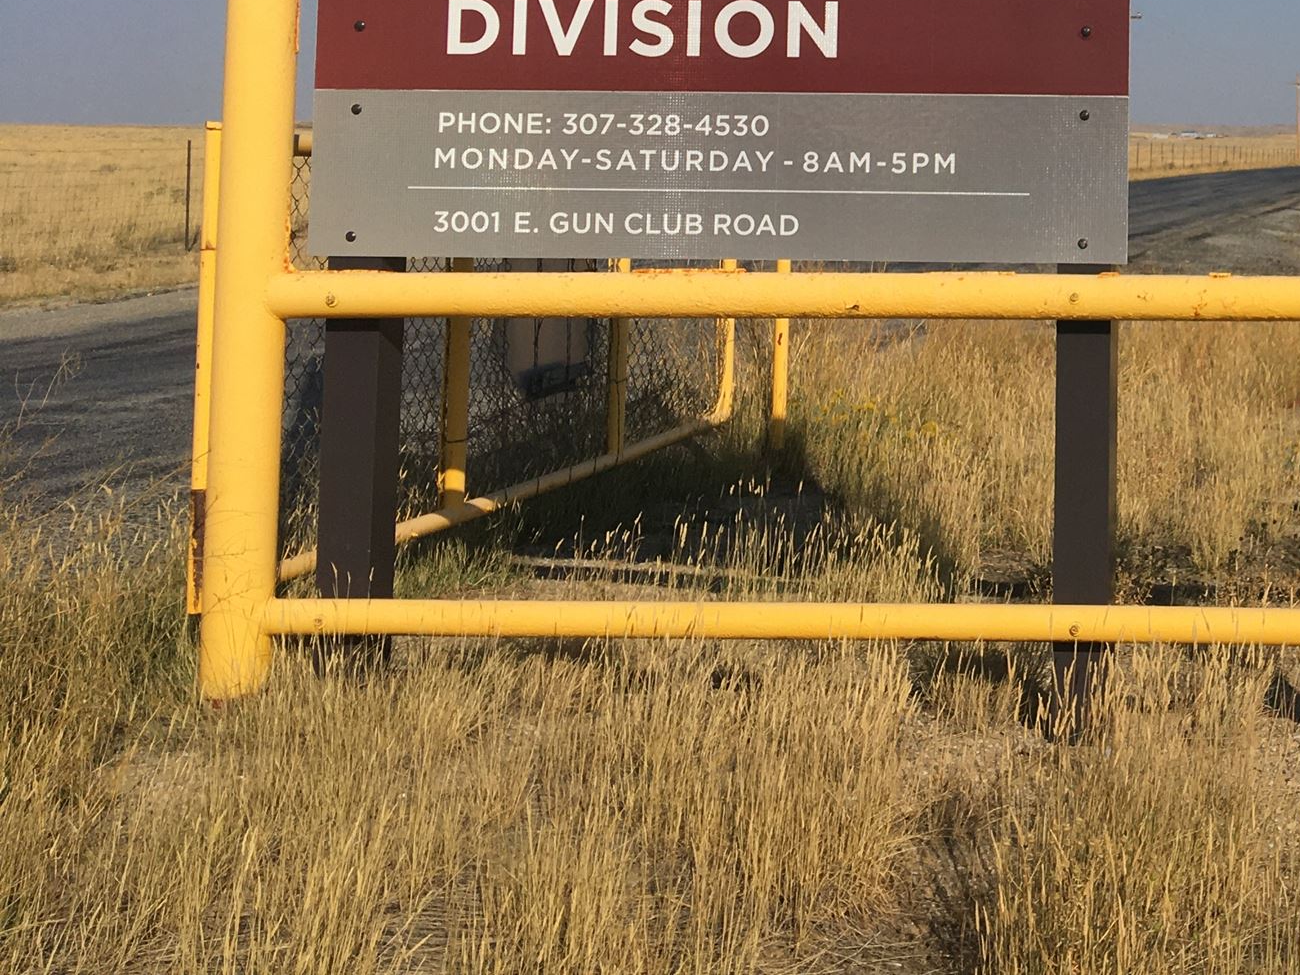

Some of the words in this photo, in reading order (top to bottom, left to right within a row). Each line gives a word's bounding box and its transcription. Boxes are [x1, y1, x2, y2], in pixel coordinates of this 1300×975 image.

[438, 111, 552, 135] PHONE:
[561, 113, 770, 137] 307-328-4530
[433, 148, 774, 173] MONDAY-SATURDAY
[802, 152, 957, 175] 8AM-5PM
[433, 211, 500, 233] 3001
[514, 212, 538, 234] E.
[549, 212, 614, 235] GUN
[624, 212, 702, 235] CLUB
[712, 214, 800, 236] ROAD
